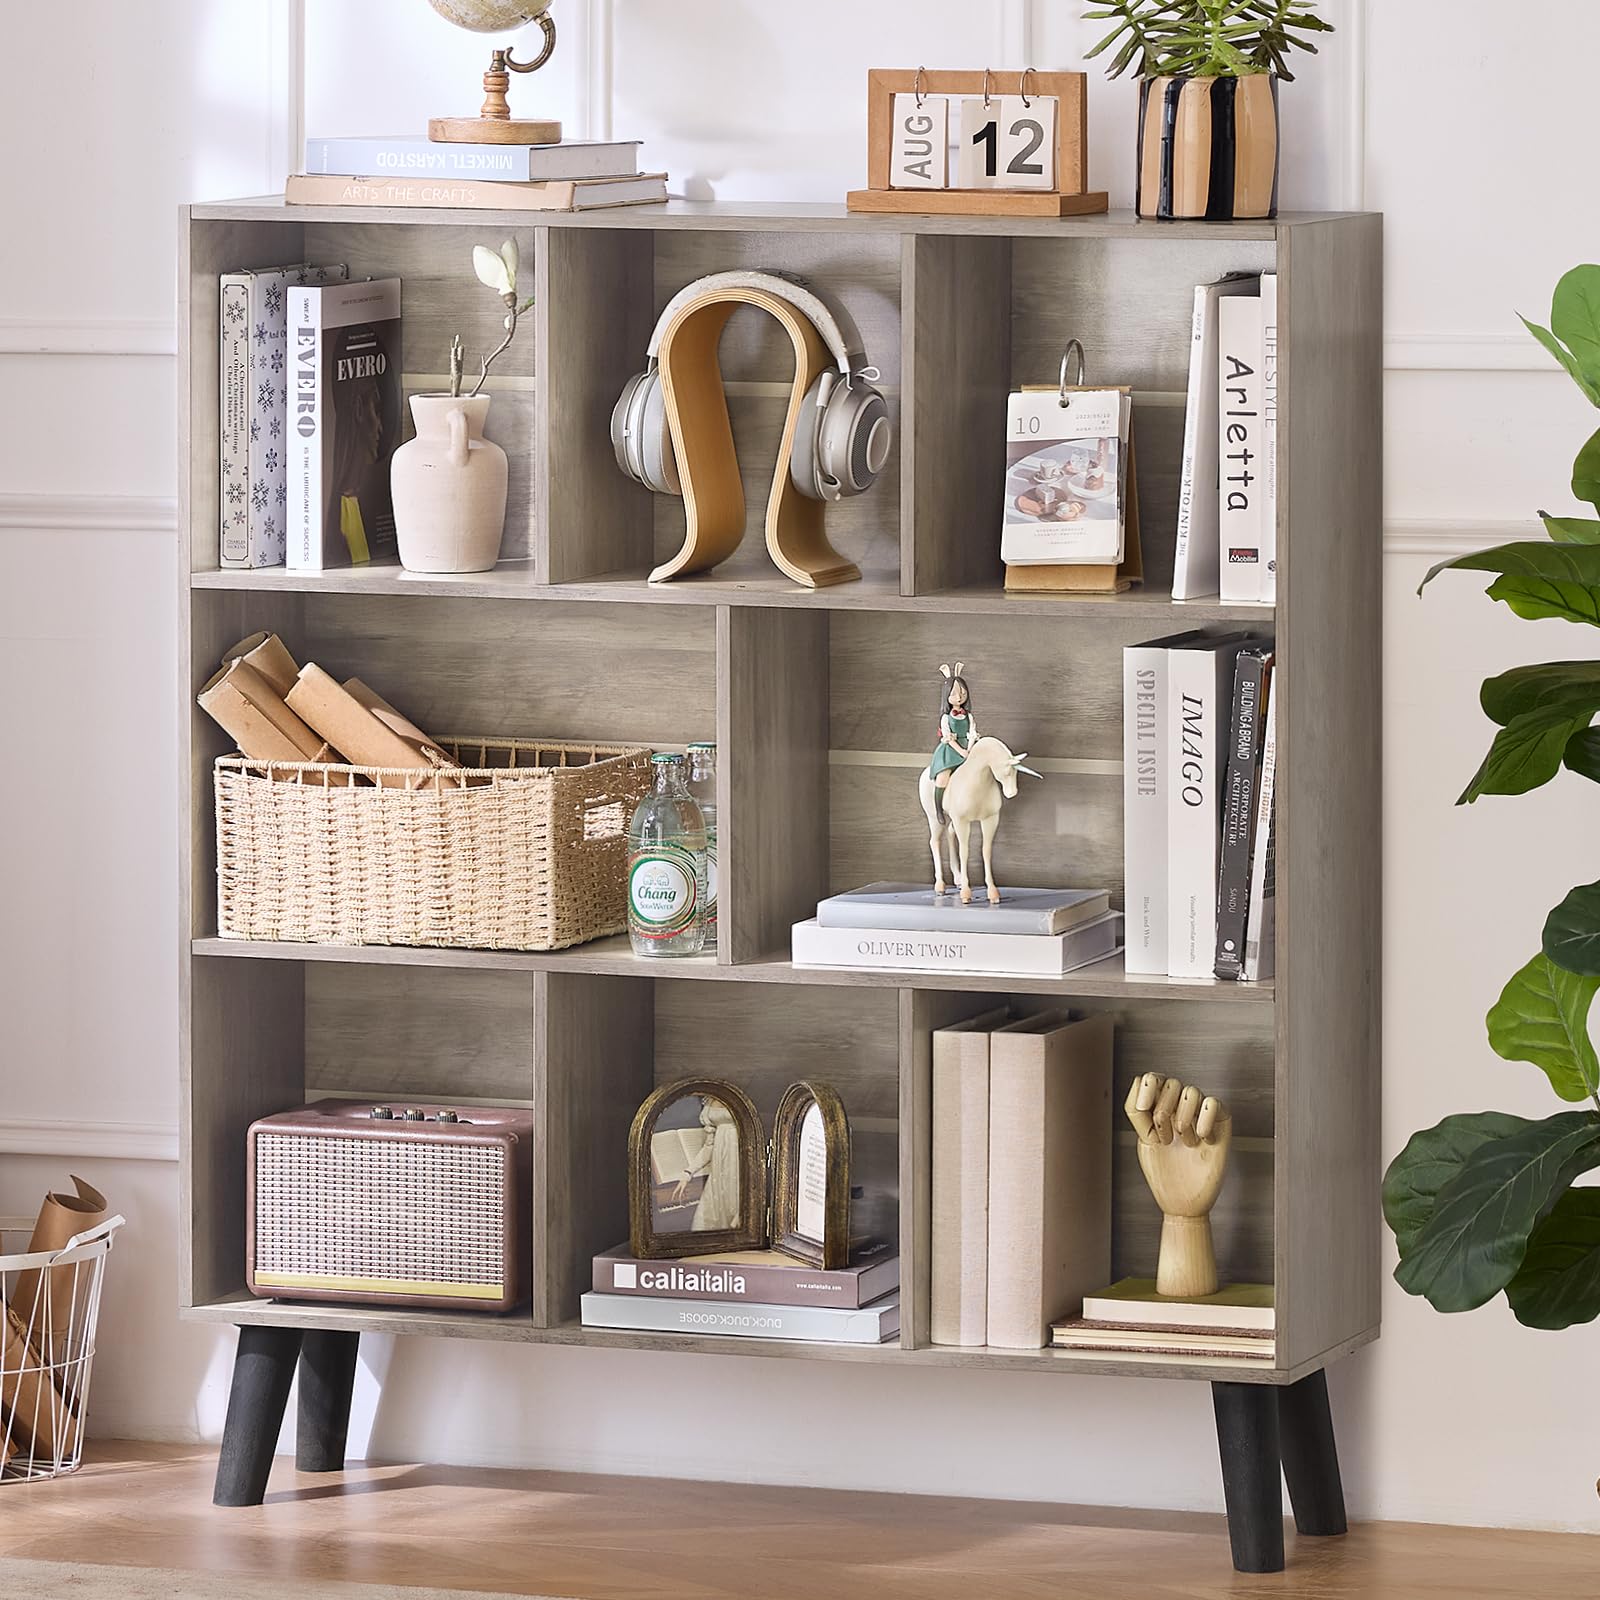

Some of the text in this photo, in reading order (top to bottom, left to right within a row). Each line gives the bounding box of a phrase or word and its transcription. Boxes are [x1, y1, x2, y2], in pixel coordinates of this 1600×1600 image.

[376, 151, 513, 170] MIKKETL KARSTOD
[903, 114, 934, 180] AUG
[971, 119, 1044, 177] 12
[343, 187, 476, 203] ARTS THE CRAFTS
[297, 327, 316, 438] EVERO
[337, 353, 387, 382] EVERO
[1015, 416, 1041, 434] 10
[1226, 355, 1257, 511] Arletta
[1179, 479, 1192, 538] KINFOLK
[1136, 670, 1156, 796] SPECIAL ISSUE
[1182, 692, 1204, 808] IMAGO
[1228, 769, 1240, 847] ARCHITECTURE
[1238, 779, 1251, 840] CORPORATE
[1260, 742, 1275, 823] STYLE AT HOME
[638, 885, 677, 903] Chang
[1228, 888, 1238, 914] SANDU
[857, 941, 967, 959] OLIVER TWIST
[639, 1267, 746, 1295] caliaitalia
